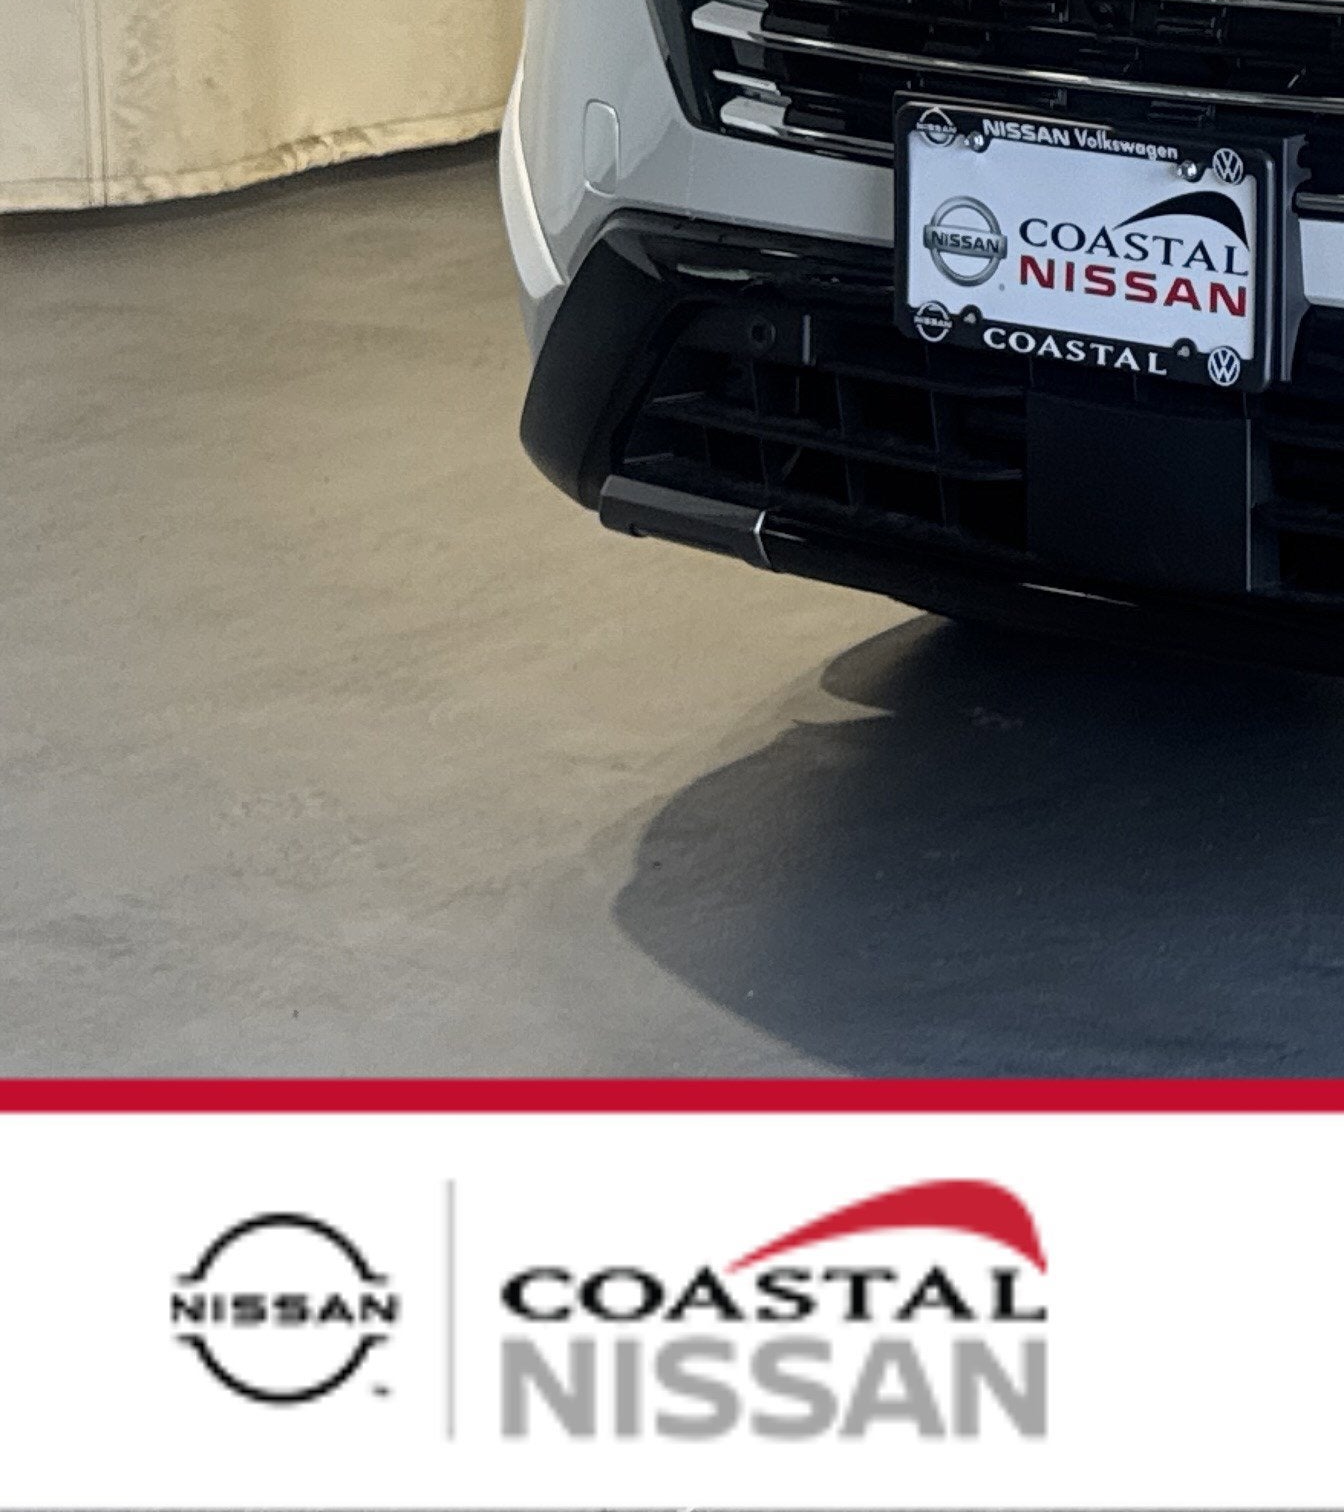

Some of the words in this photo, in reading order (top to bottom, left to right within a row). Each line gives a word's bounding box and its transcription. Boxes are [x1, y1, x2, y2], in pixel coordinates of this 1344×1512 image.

[982, 118, 1070, 147] NISSAN
[1074, 127, 1179, 162] Volkswagen
[931, 231, 1000, 255] NISSAN
[1018, 218, 1249, 277] COASTAL
[1019, 254, 1247, 318] NISSAN
[982, 327, 1168, 376] COASTAL
